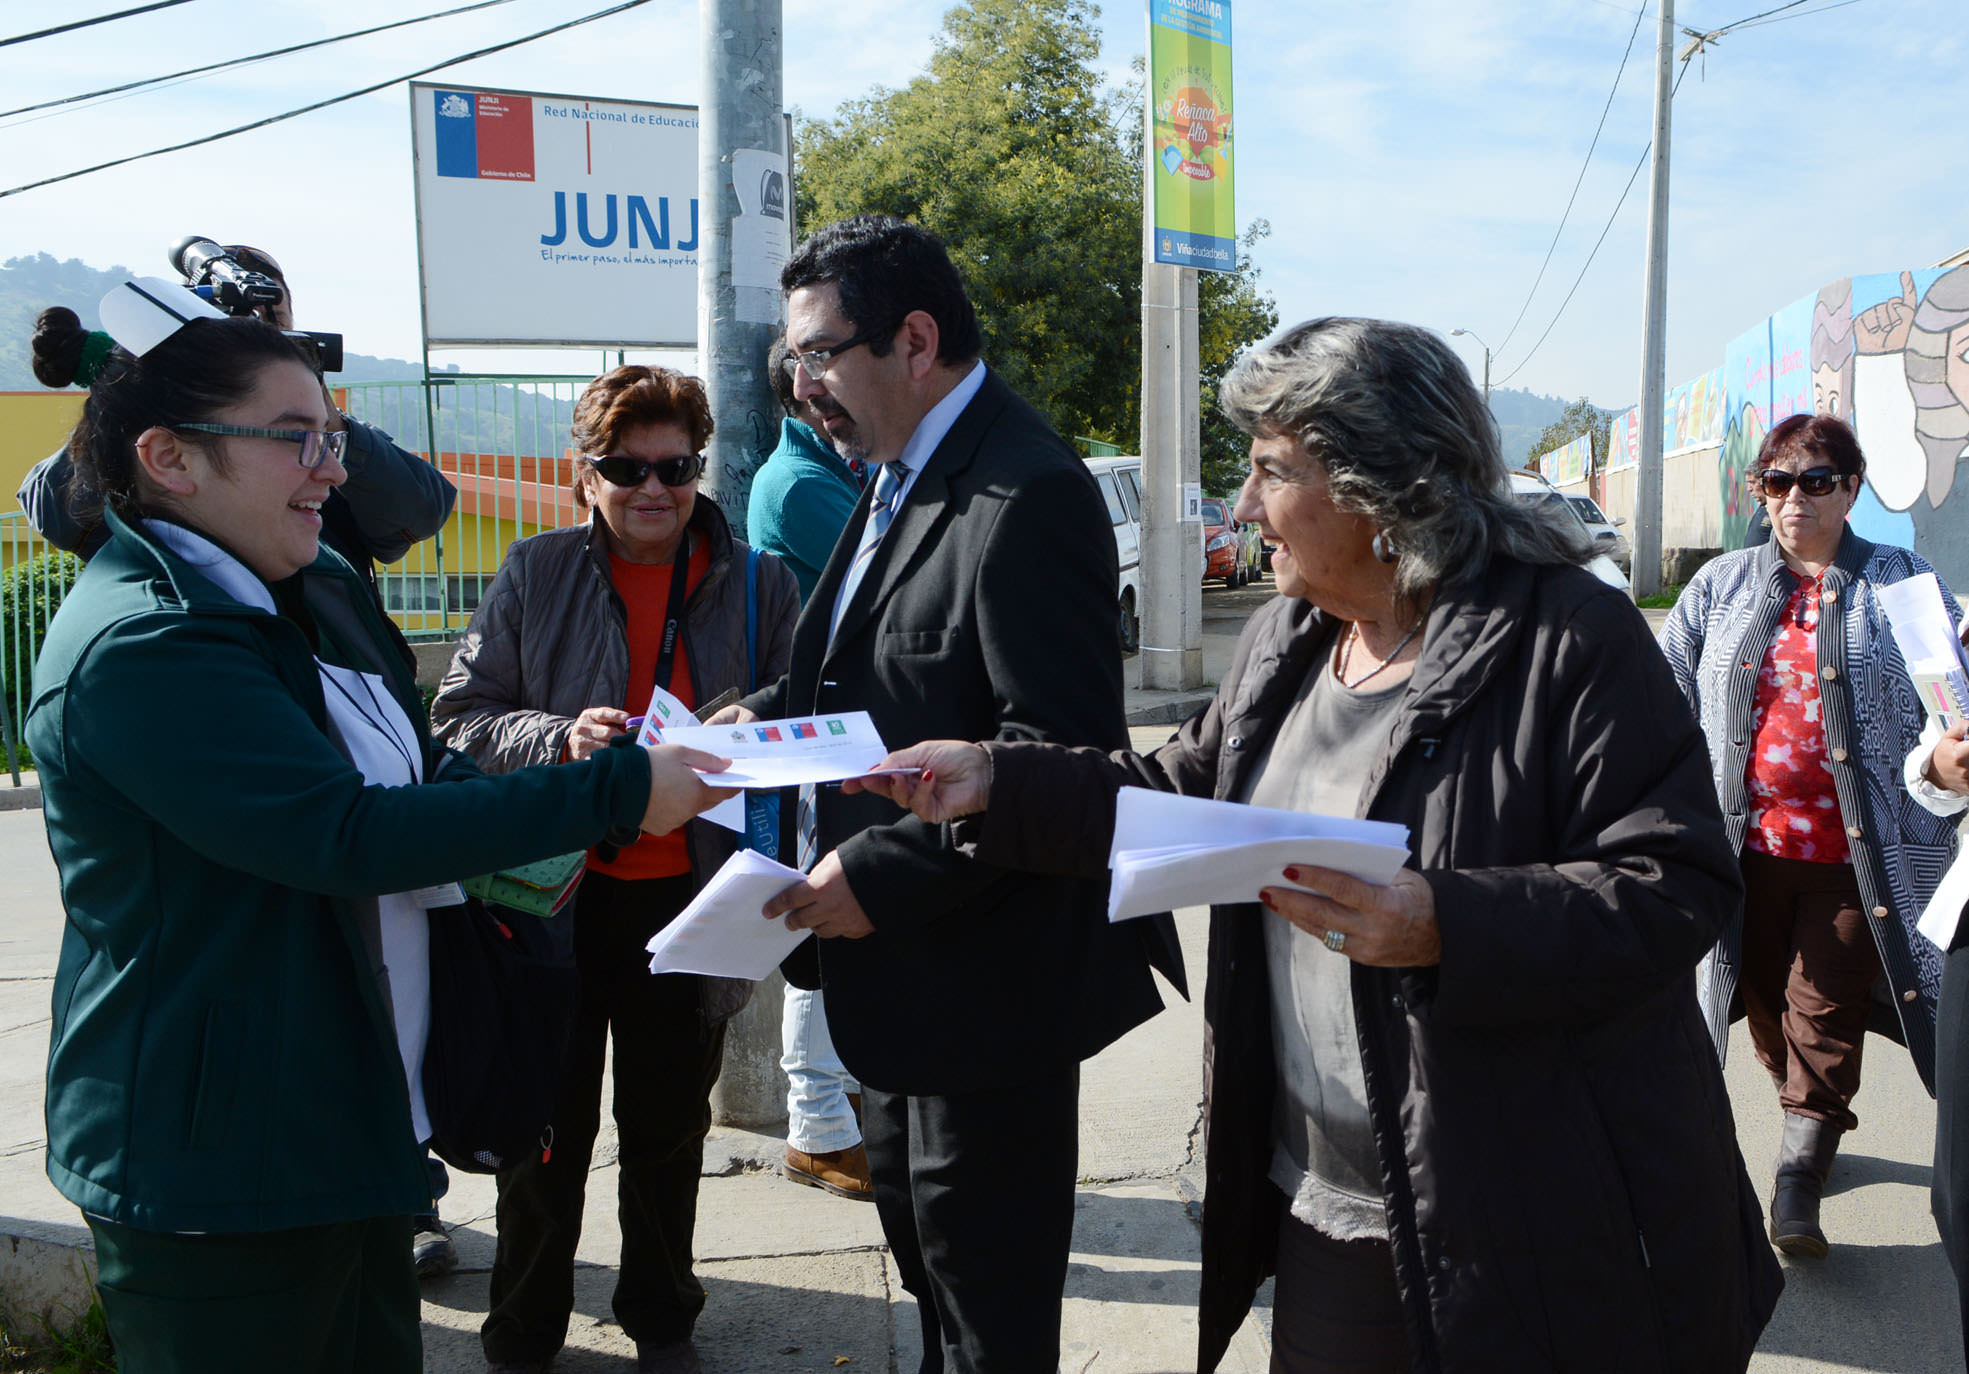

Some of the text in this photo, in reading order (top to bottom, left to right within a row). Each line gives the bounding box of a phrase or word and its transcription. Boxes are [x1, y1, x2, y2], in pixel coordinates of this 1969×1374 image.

[544, 105, 567, 118] Red
[571, 108, 627, 123] Nacional
[631, 113, 646, 124] de
[1177, 98, 1215, 122] Reñaca
[1187, 121, 1208, 143] Alto
[540, 191, 699, 252] JUNJ
[541, 249, 553, 261] El
[556, 253, 589, 265] primer
[623, 251, 632, 263] el
[634, 255, 656, 265] más
[658, 256, 698, 268] importa
[664, 619, 677, 653] Canon
